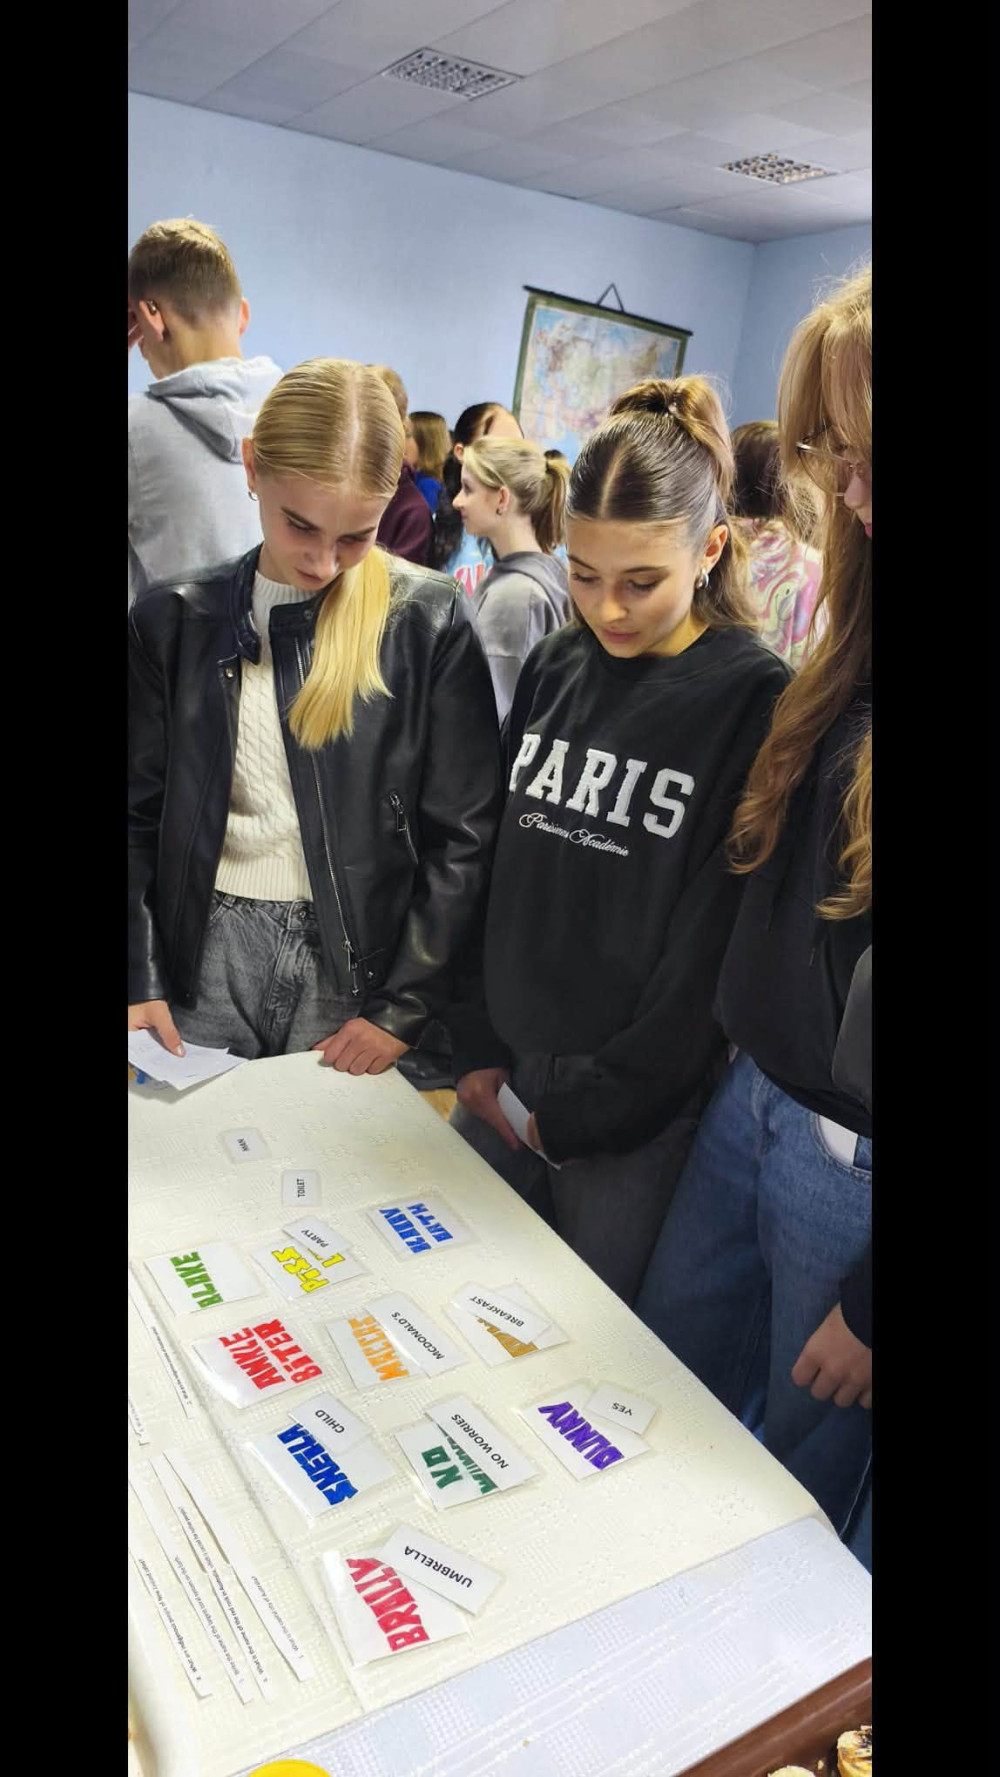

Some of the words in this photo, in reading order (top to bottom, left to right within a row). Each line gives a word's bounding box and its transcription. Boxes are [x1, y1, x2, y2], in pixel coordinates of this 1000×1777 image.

[509, 733, 695, 839] PARIS
[297, 1178, 305, 1198] TOILET
[300, 1228, 329, 1248] PARTY
[469, 1295, 525, 1328] BREAKFAST
[391, 1310, 445, 1361] MCDONALD'S
[218, 1326, 286, 1390] ANKLE
[315, 1409, 345, 1434] CHILD
[612, 1402, 633, 1417] YES
[451, 1414, 492, 1454] WORRIES
[537, 1401, 625, 1471] DUNNY
[421, 1445, 463, 1490] NO
[491, 1453, 509, 1469] NO
[403, 1544, 473, 1588] UMBRELLA
[345, 1557, 430, 1652] BROLLY
